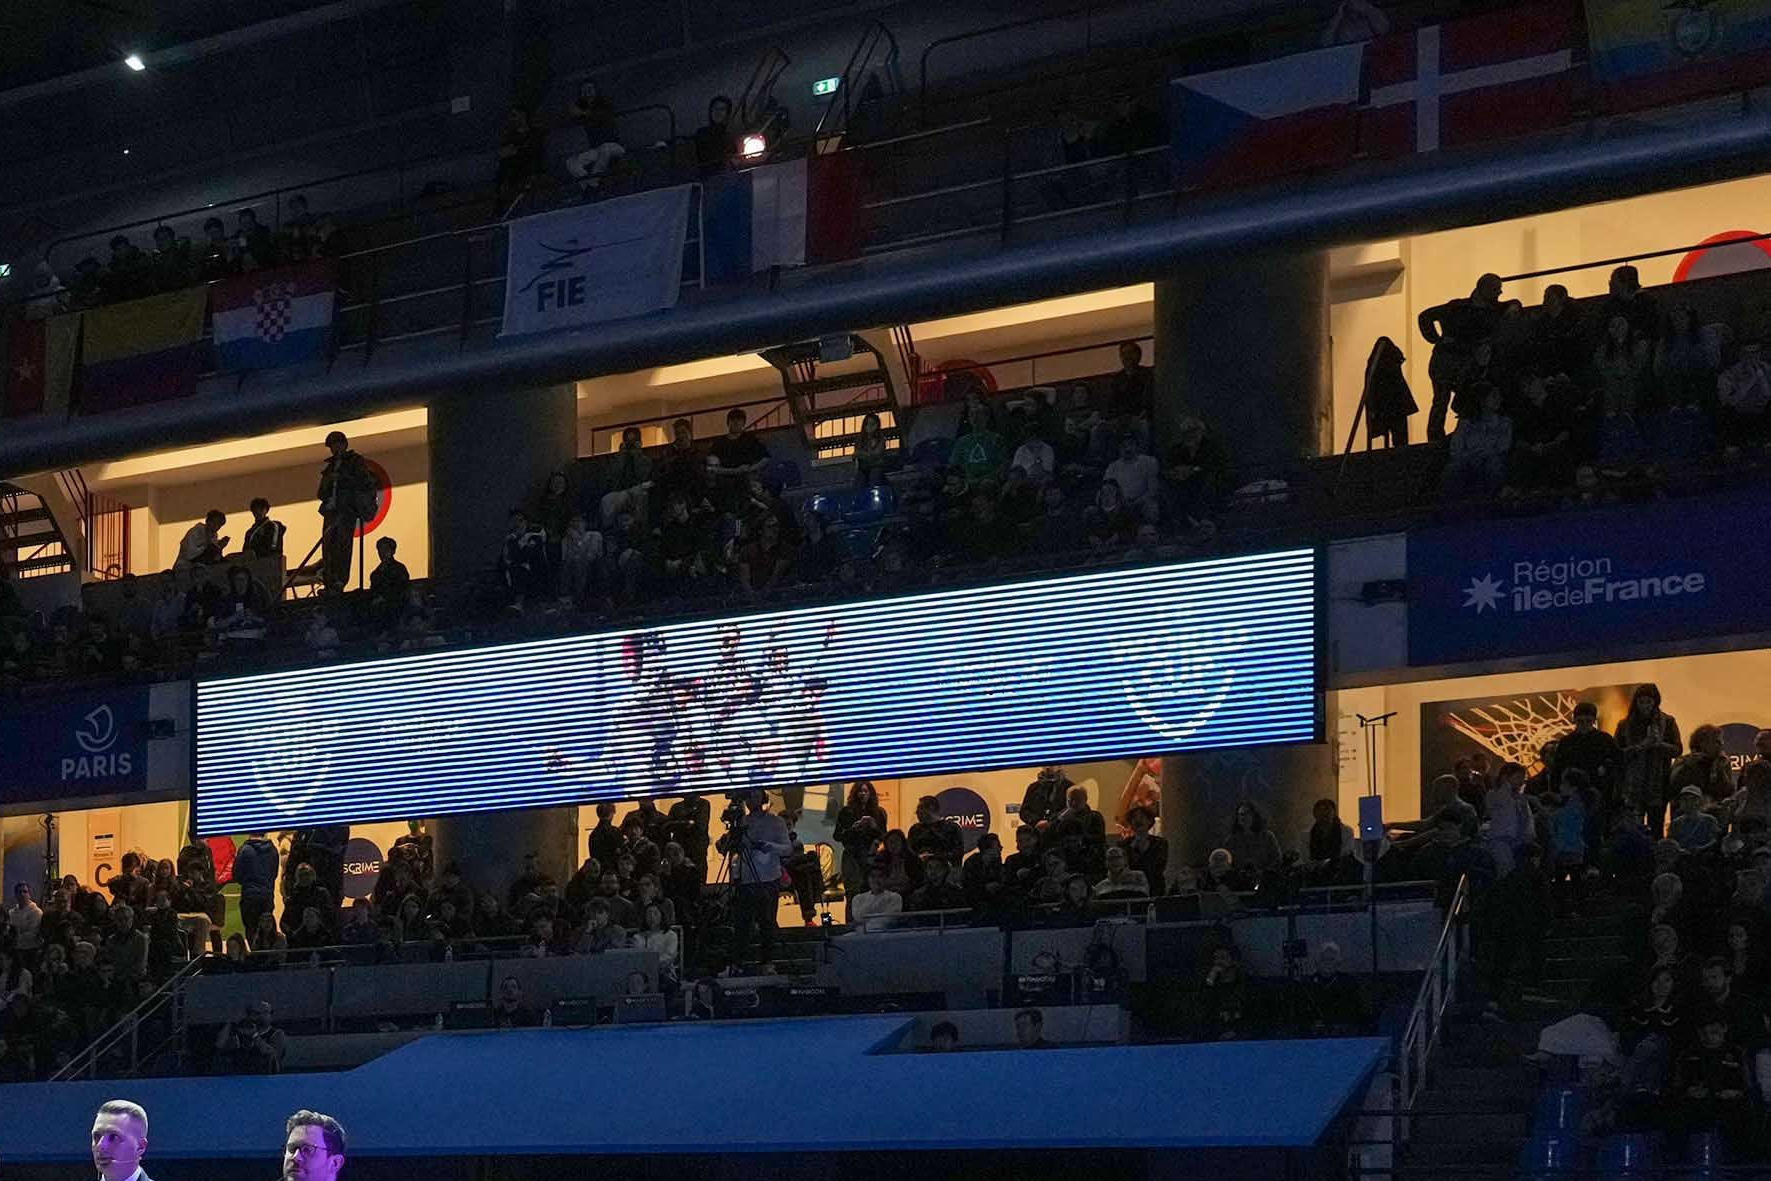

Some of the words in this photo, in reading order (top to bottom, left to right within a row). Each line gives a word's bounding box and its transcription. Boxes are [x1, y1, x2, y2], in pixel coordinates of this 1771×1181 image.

[537, 276, 586, 313] FIE
[1513, 555, 1612, 585] Région
[59, 752, 133, 781] PARIS
[94, 862, 112, 887] C
[342, 860, 380, 875] SCRIME
